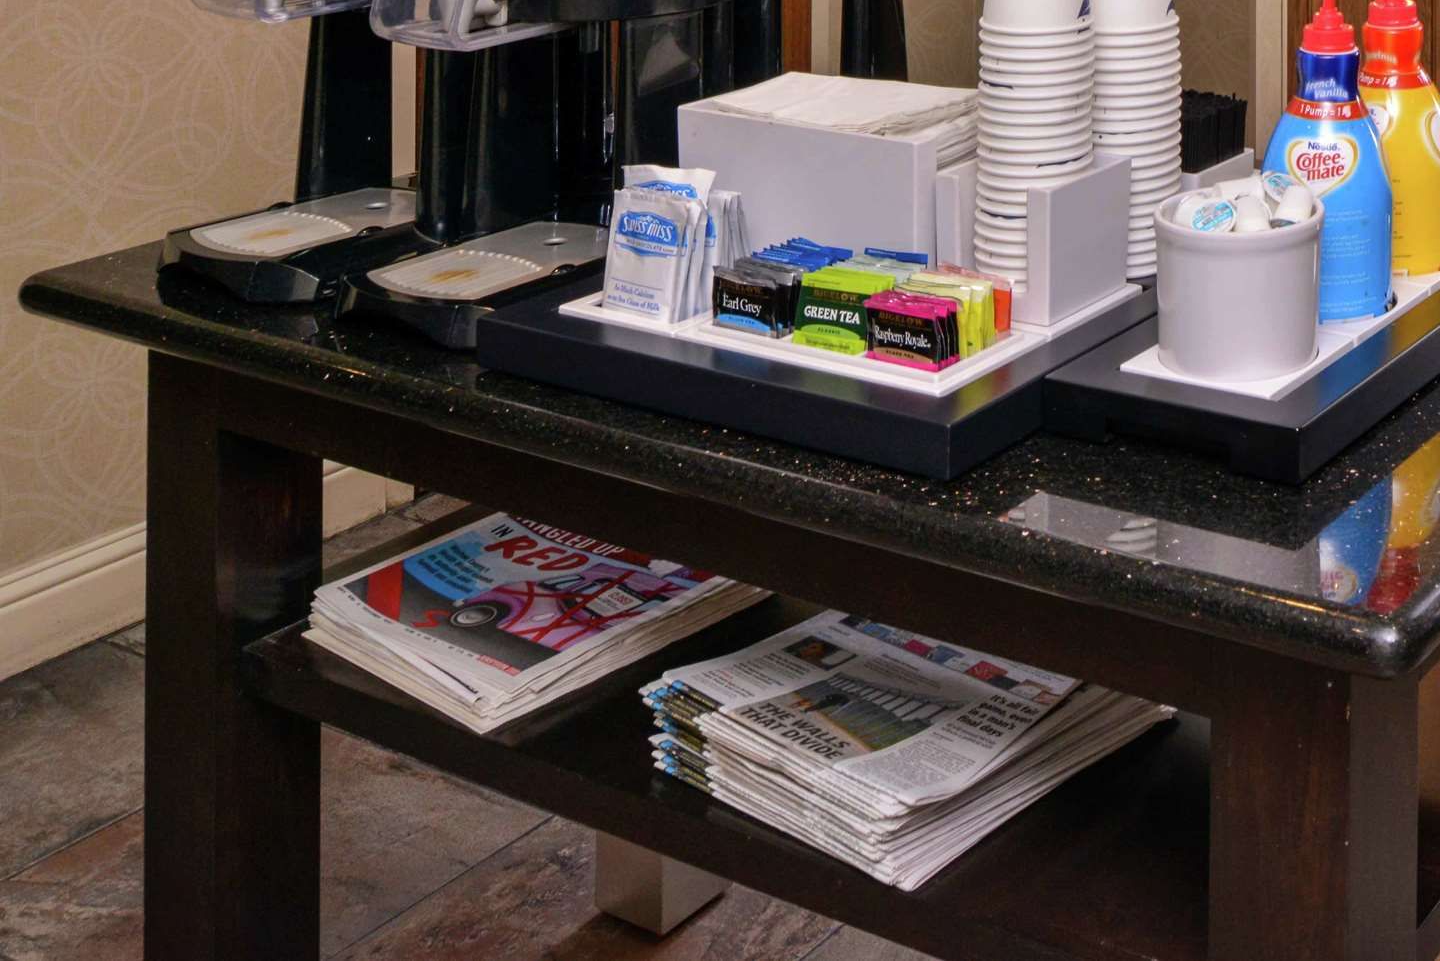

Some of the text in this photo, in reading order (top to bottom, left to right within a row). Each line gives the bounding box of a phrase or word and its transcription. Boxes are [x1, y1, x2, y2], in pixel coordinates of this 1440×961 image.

[1305, 77, 1336, 93] French
[1314, 87, 1349, 99] Vanilla
[1305, 105, 1328, 118] Pump
[1306, 164, 1345, 181] mate
[647, 223, 674, 243] MISS
[722, 291, 762, 317] Earl Grey
[804, 305, 860, 325] GREEN TEA
[874, 325, 904, 347] Raspberry
[491, 523, 514, 539] IN
[516, 517, 625, 557] ANGLED UP
[484, 534, 590, 571] RED
[740, 707, 845, 759] THAT DIVIDE
[760, 702, 852, 749] THE WALLS
[979, 725, 1003, 737] days
